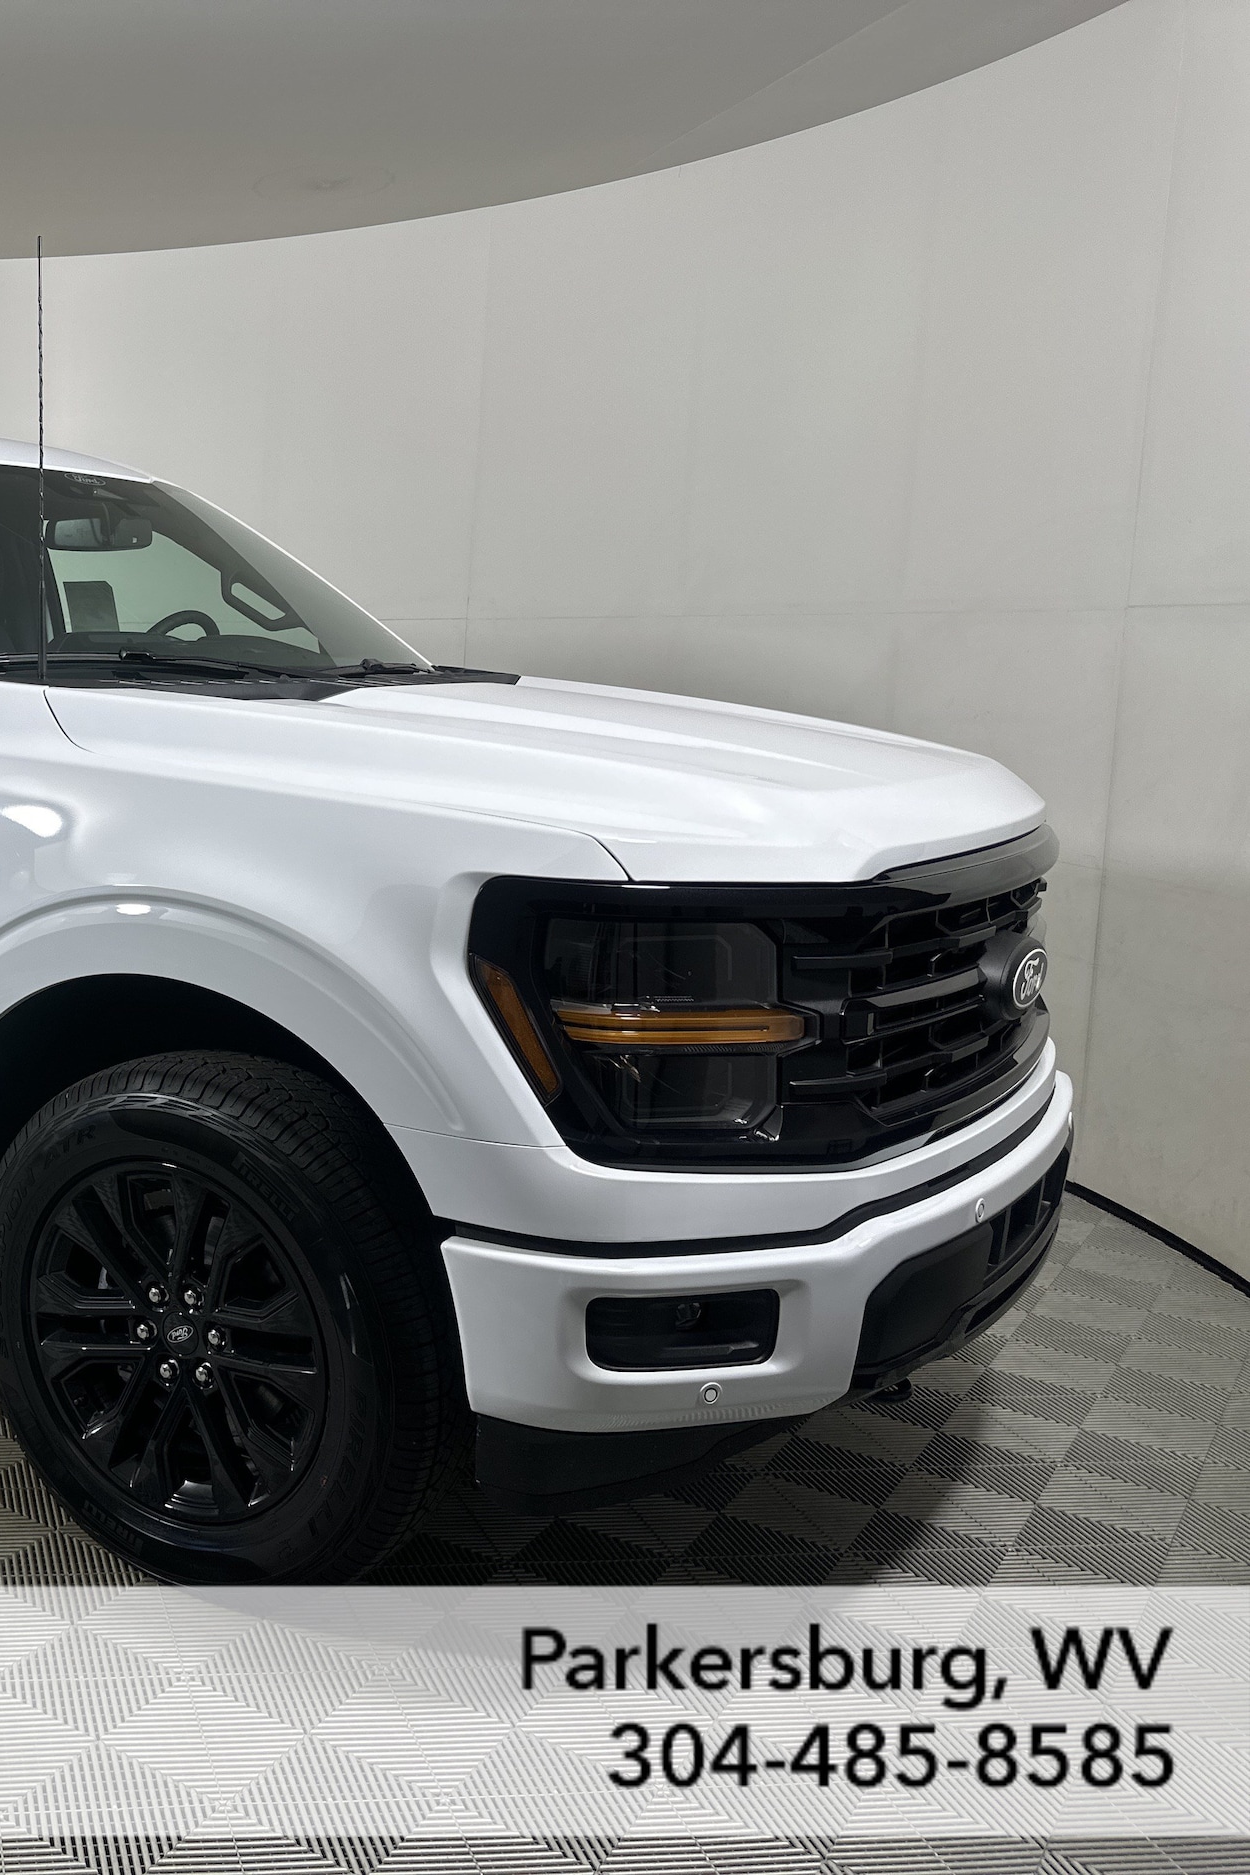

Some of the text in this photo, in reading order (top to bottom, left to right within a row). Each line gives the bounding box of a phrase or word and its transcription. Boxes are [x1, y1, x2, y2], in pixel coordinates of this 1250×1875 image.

[1020, 957, 1045, 1001] Ford
[44, 1123, 97, 1170] ATR
[170, 1326, 191, 1342] Ford
